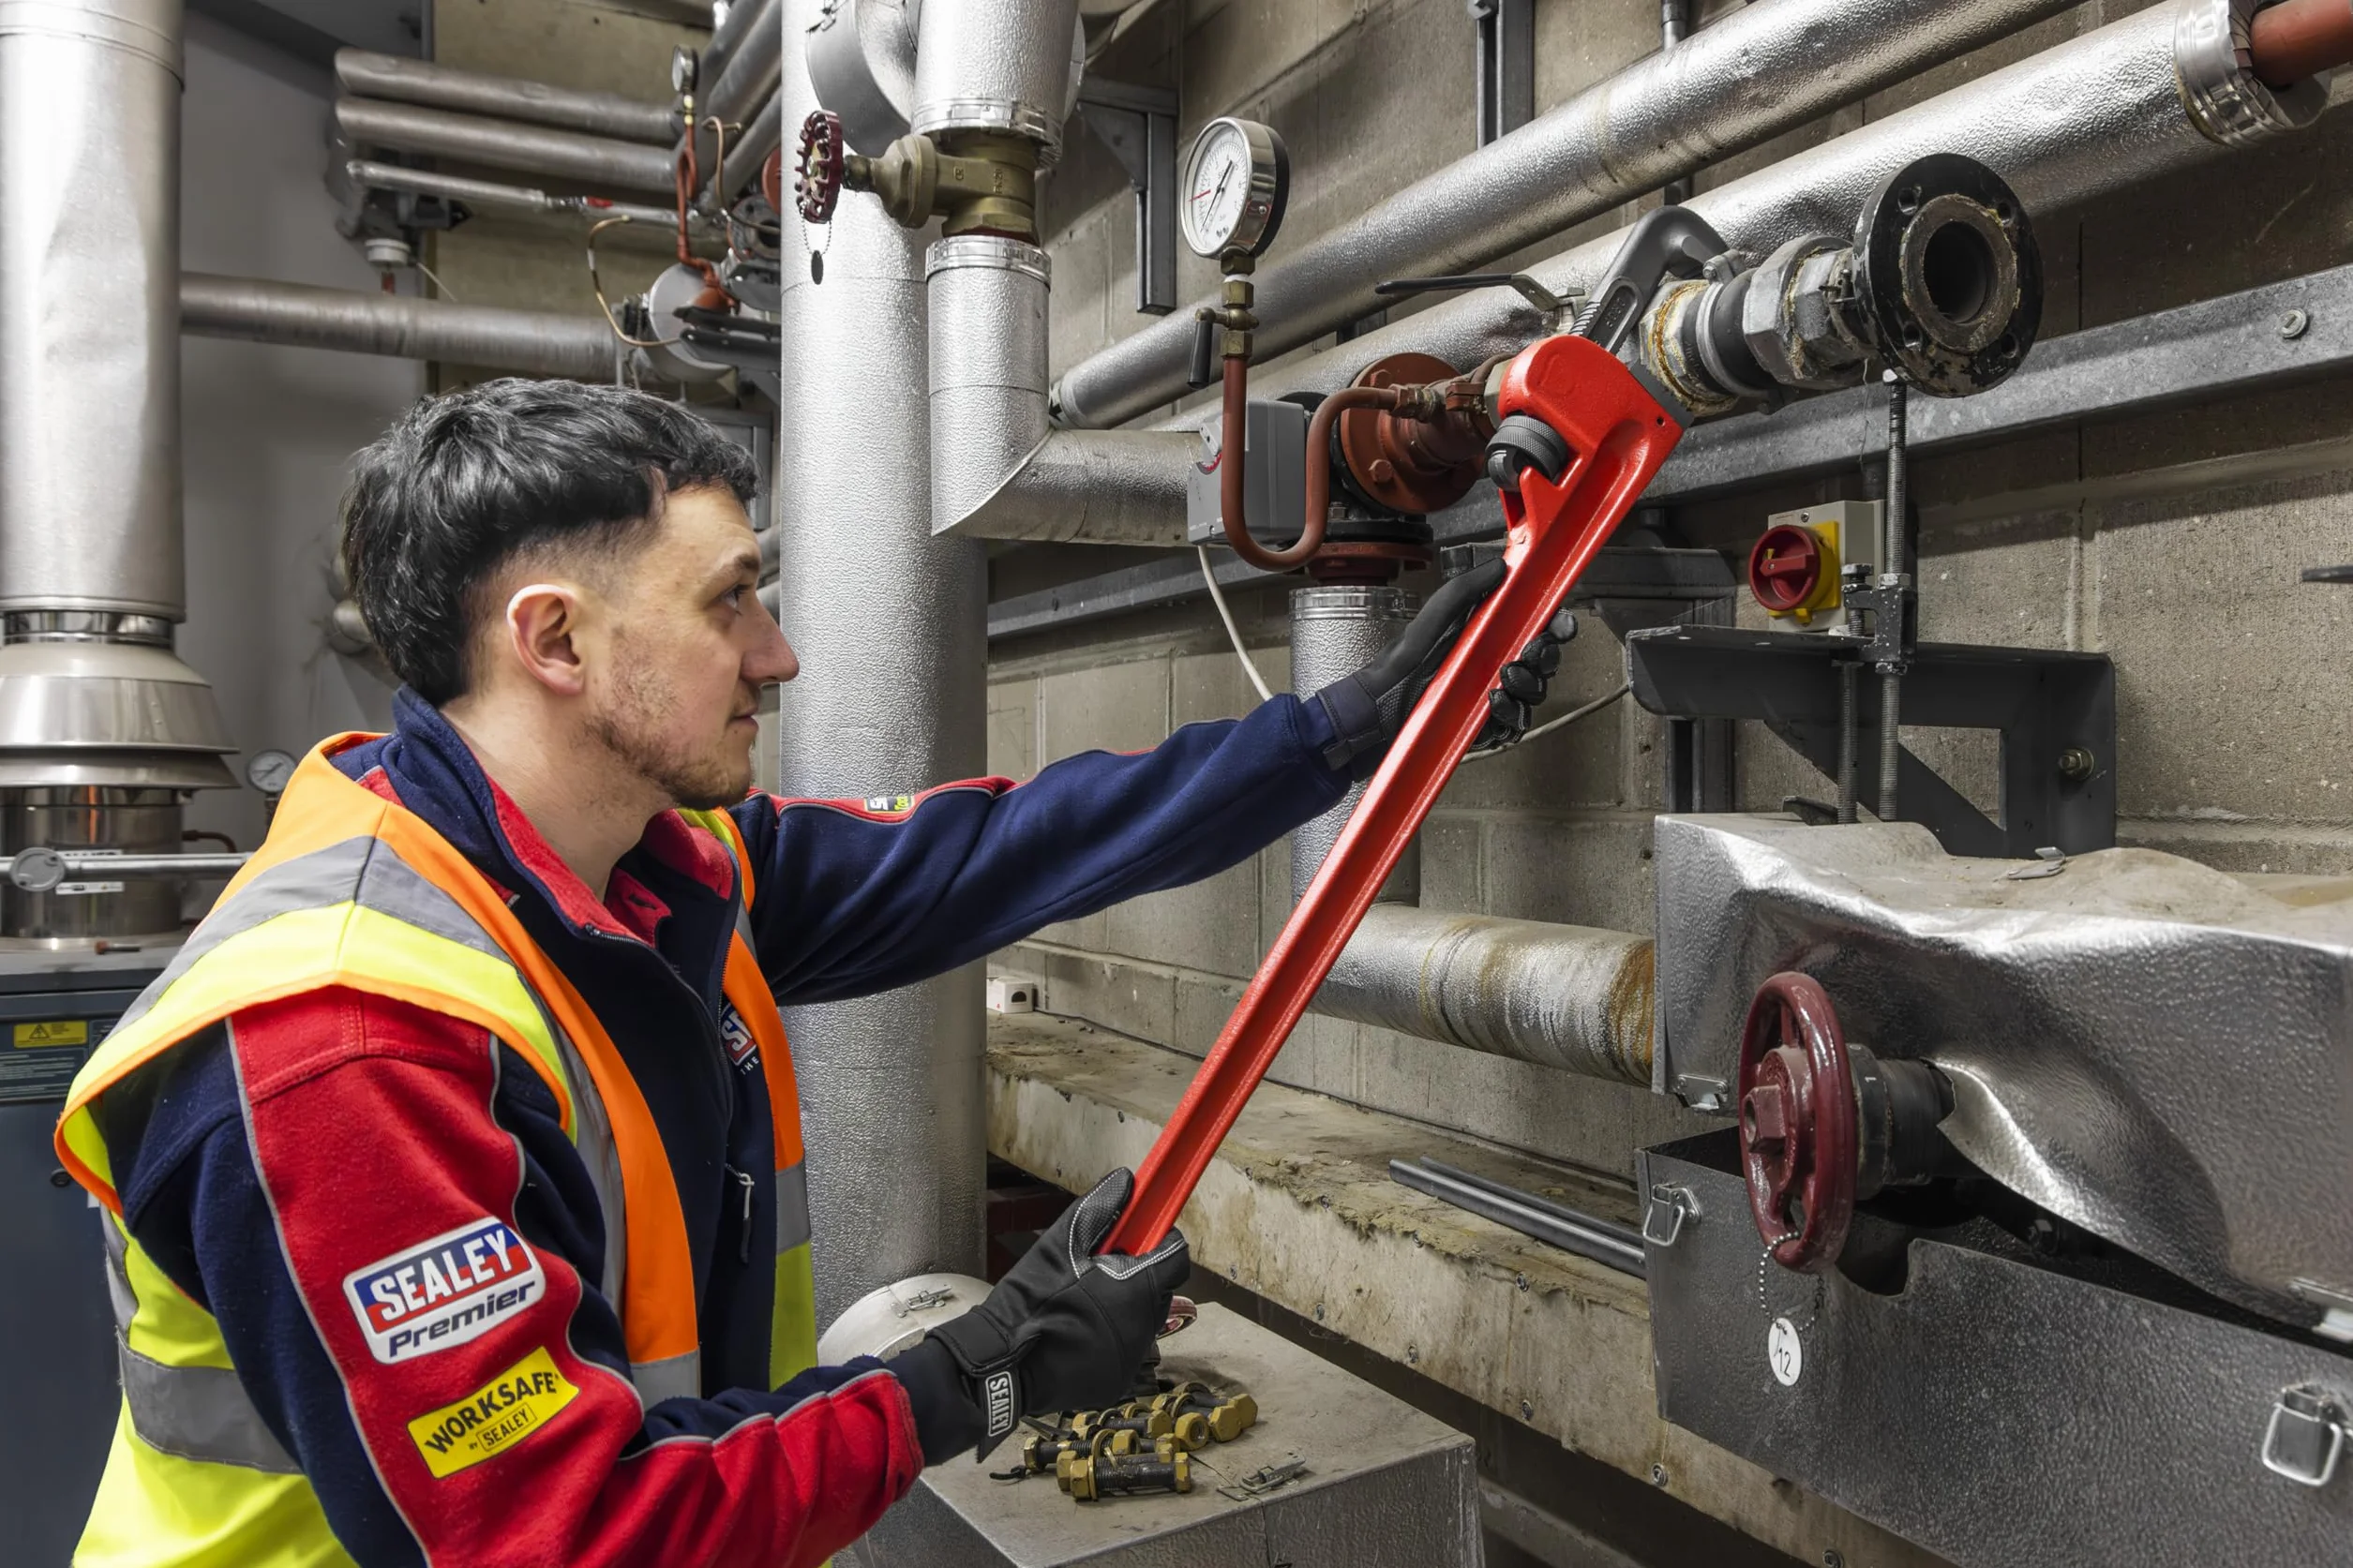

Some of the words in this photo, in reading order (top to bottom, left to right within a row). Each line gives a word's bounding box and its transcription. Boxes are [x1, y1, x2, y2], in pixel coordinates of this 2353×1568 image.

[369, 1229, 513, 1322] SEALEY
[388, 1280, 535, 1358] Premier
[425, 1371, 558, 1454] WORKSAFE
[482, 1408, 529, 1446] SEALEY
[989, 1377, 1010, 1430] SEALEY
